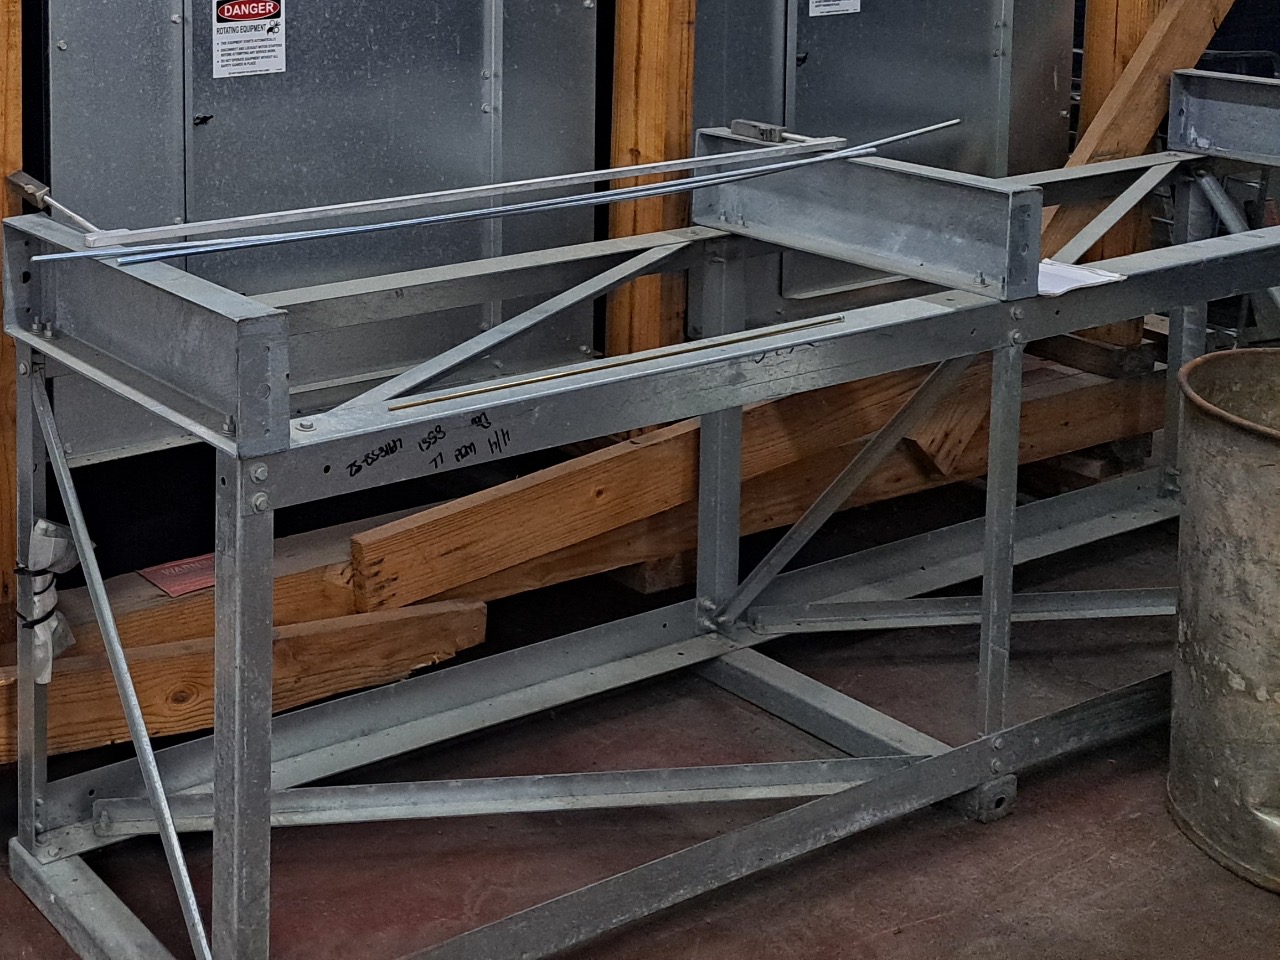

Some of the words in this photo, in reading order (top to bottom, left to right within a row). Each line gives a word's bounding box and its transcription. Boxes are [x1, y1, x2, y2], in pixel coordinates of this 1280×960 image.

[224, 2, 274, 16] DANGER
[216, 26, 240, 34] ROTATING
[240, 24, 266, 34] EQUIPMENT
